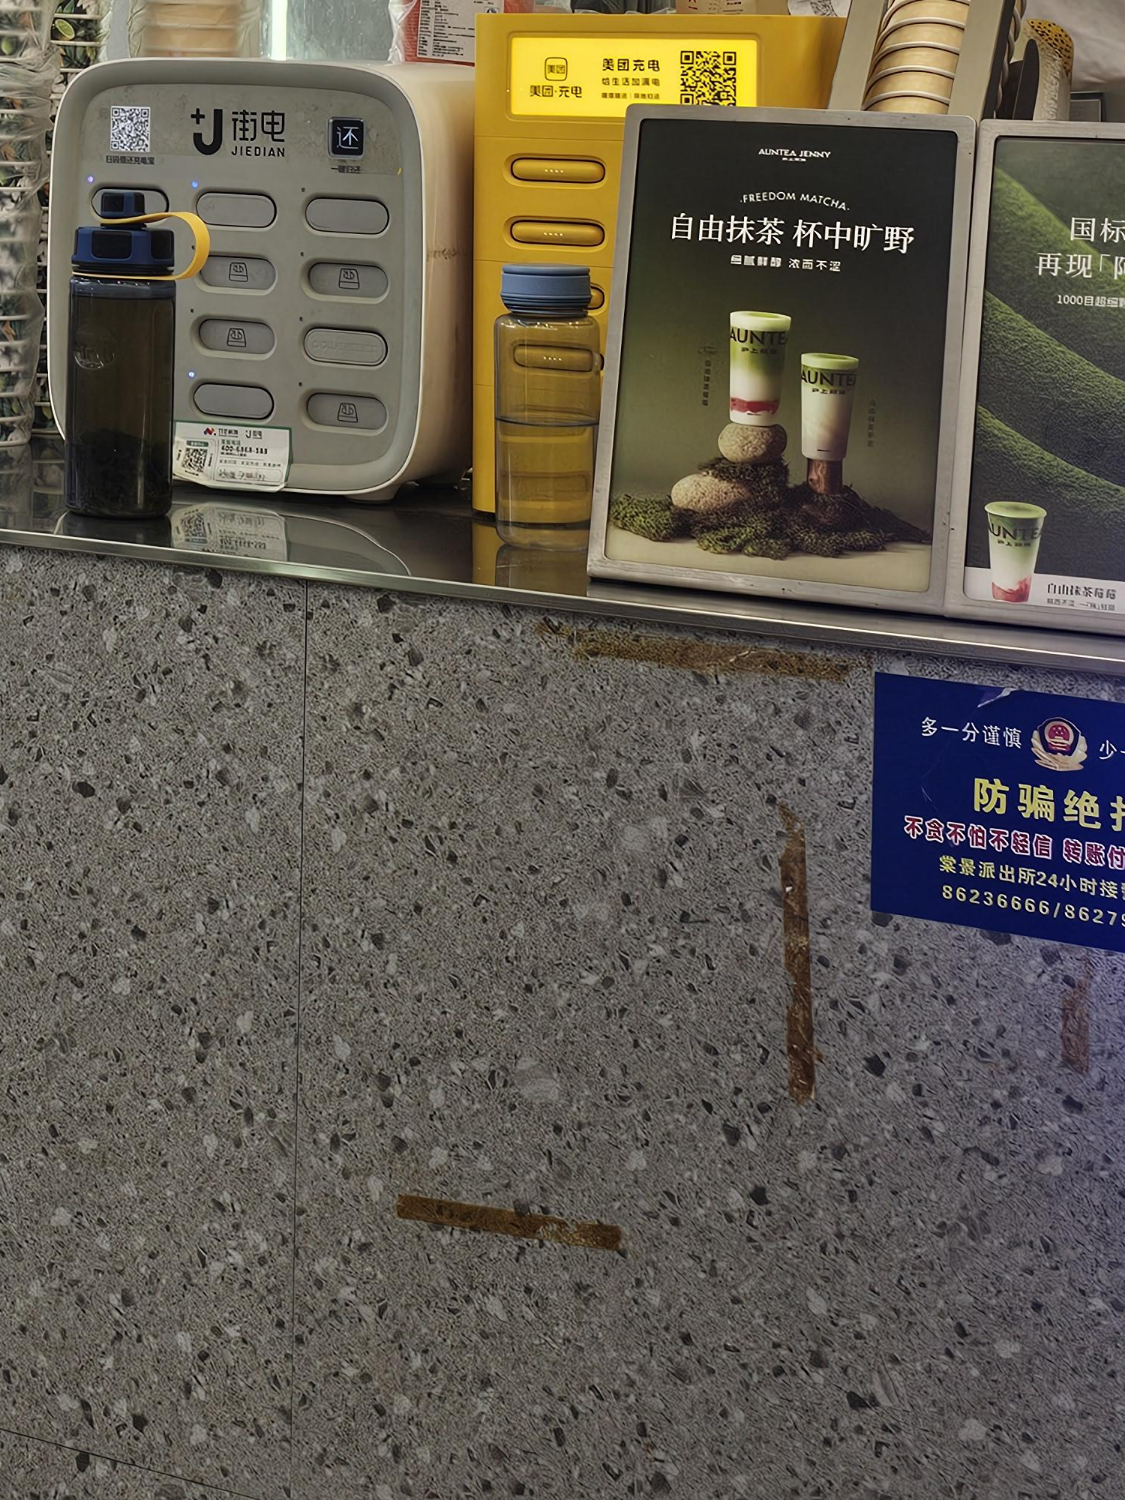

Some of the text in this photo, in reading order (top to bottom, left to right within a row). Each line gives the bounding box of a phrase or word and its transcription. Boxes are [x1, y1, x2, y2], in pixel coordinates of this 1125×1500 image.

[602, 58, 660, 72] 美团充电
[231, 110, 286, 143] 街电
[336, 126, 359, 150] 还
[231, 145, 286, 158] JIEDIAN
[758, 148, 832, 158] AUNTEA JENNY
[671, 212, 915, 254] 自由抹茶 杯中旷野
[921, 717, 1022, 749] 多一分谨慎
[903, 815, 1053, 860] 不贪不怕不轻信
[939, 855, 1125, 901] 棠景派出所24小时接
